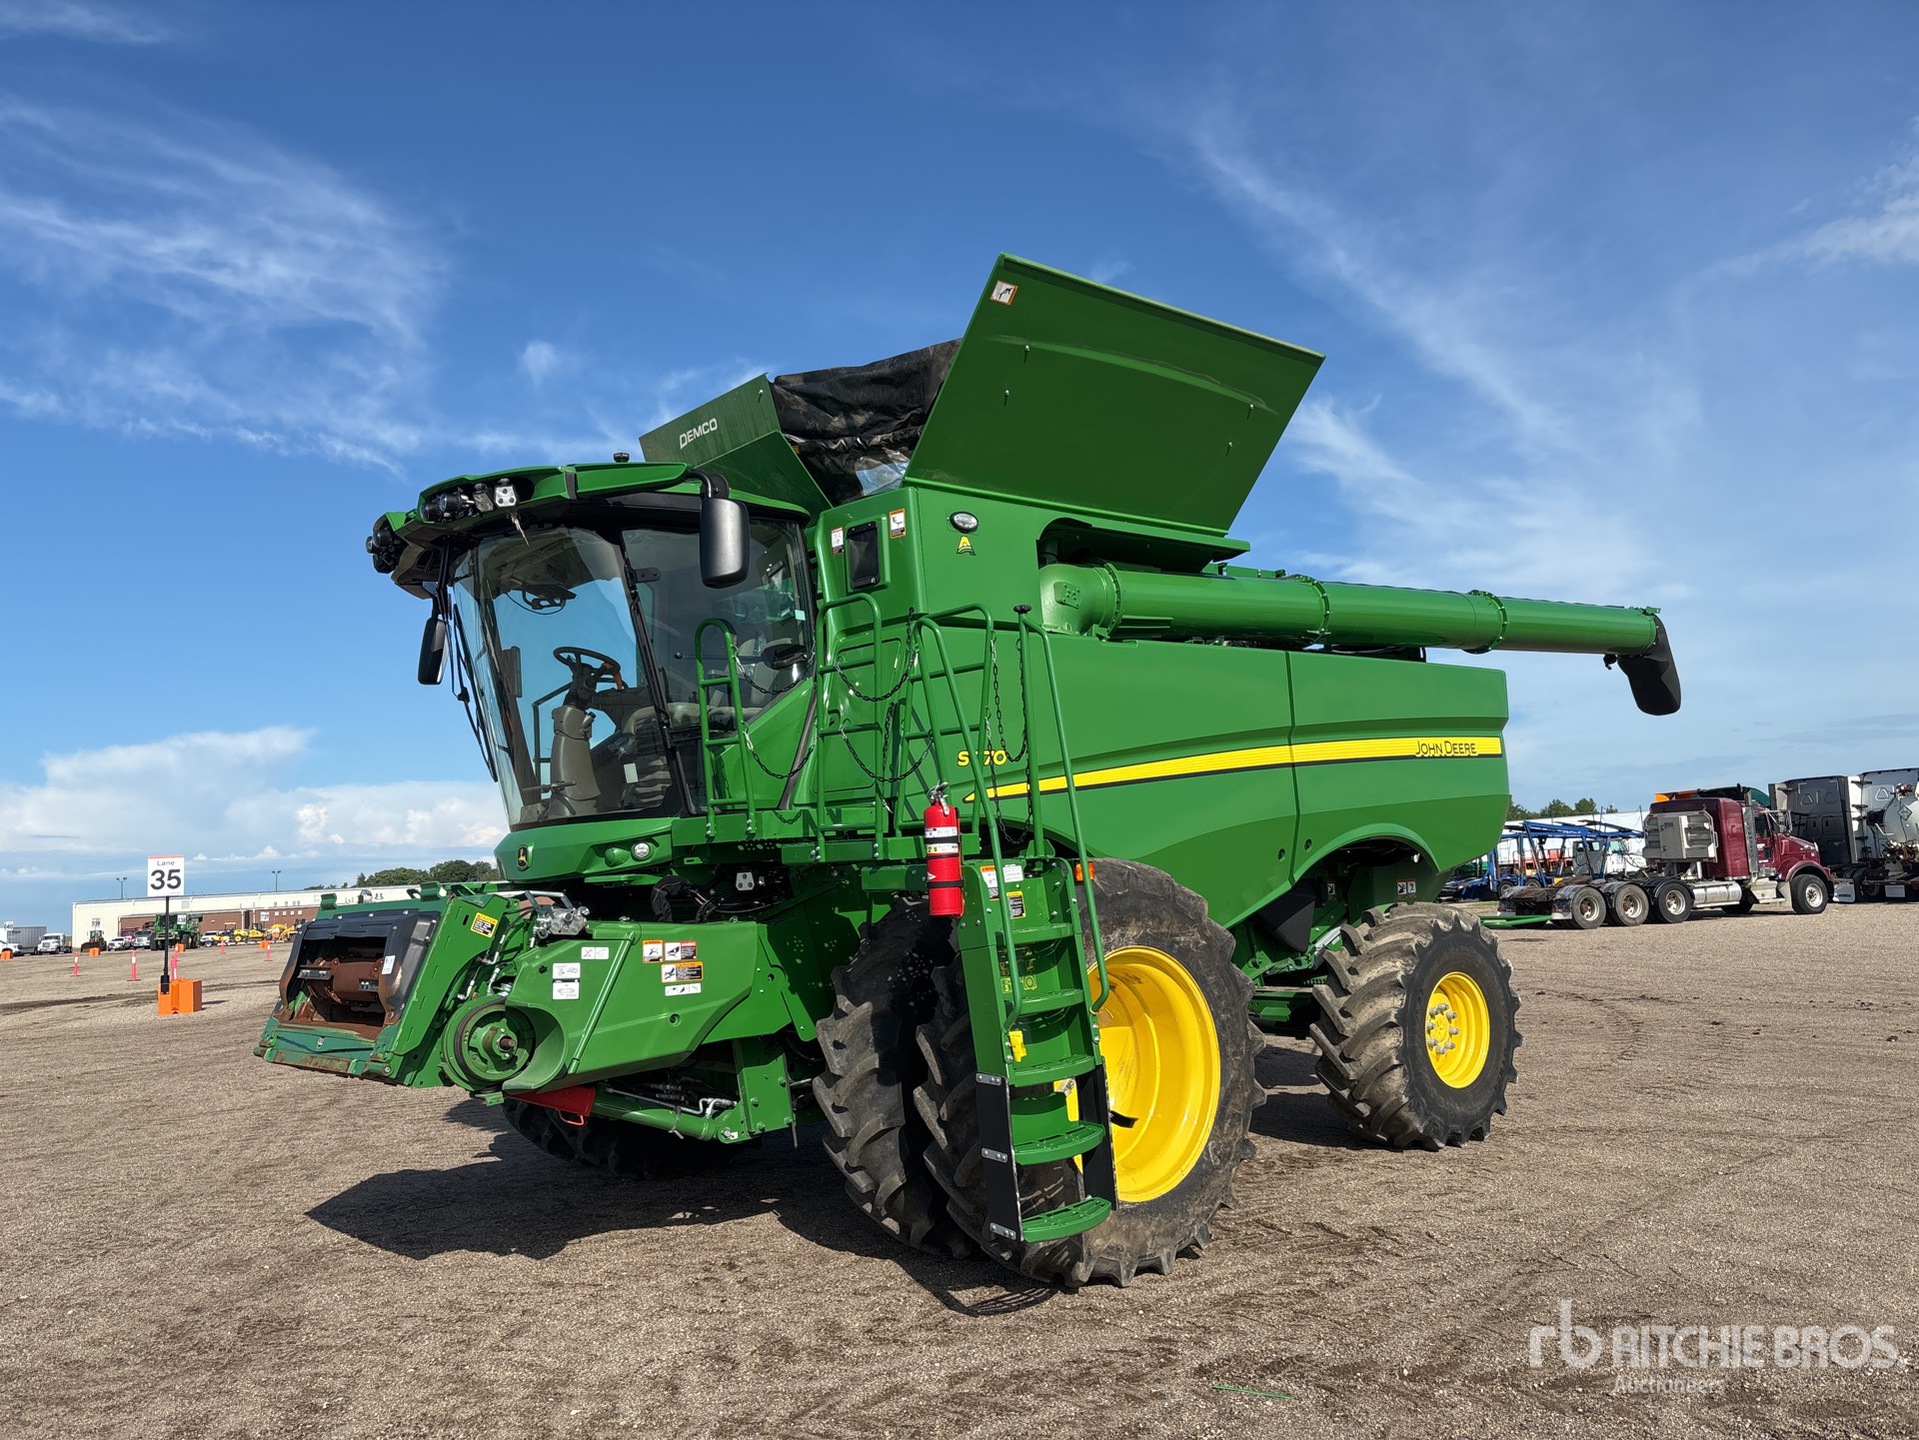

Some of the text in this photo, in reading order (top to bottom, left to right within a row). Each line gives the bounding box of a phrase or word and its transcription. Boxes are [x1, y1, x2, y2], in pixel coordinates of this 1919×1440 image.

[679, 418, 718, 450] DEMCO
[1415, 740, 1478, 755] JOHN DEERE
[957, 750, 1007, 766] S70
[150, 868, 182, 890] 35
